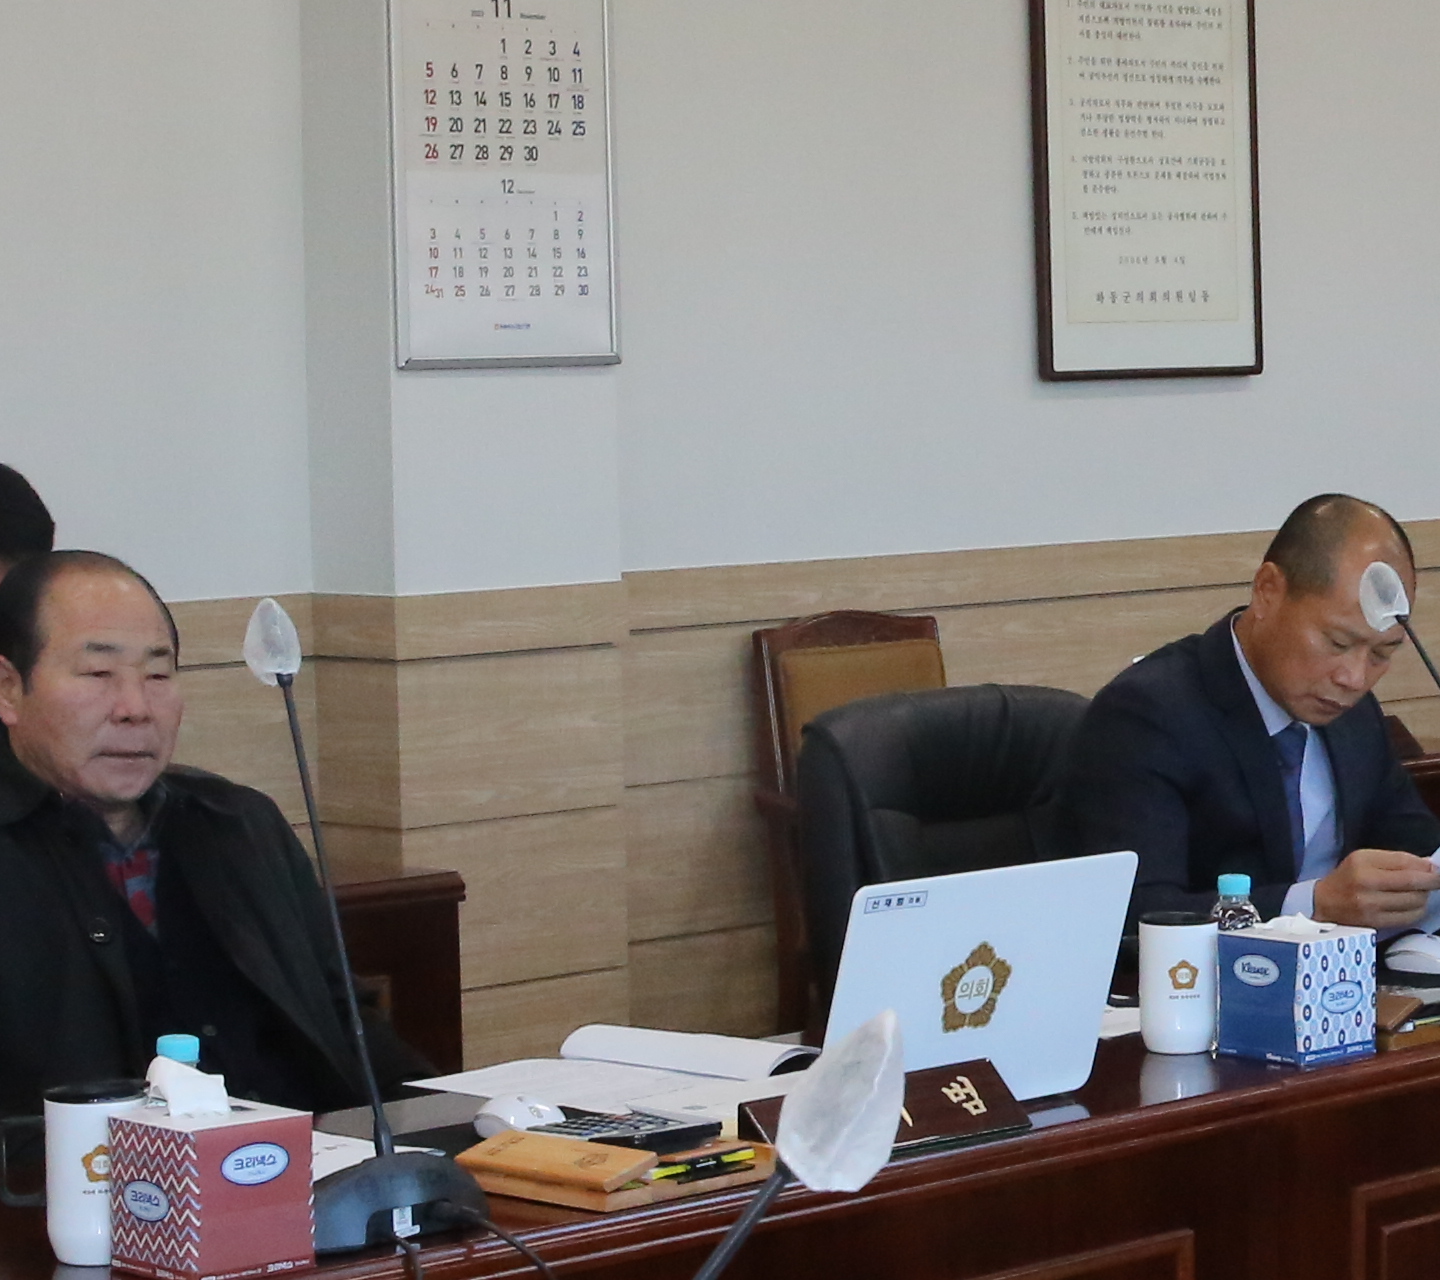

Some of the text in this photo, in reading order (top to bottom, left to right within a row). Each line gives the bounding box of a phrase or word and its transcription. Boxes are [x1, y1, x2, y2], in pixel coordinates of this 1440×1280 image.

[501, 38, 580, 57] 1 2 3 4
[426, 62, 582, 83] 5 6 7 8 9 10 11
[424, 89, 584, 110] 12 13 14 15 16 17 18
[425, 116, 586, 136] 19 20 21 22 23 24 25
[425, 143, 538, 161] 26 27 28 29 30
[501, 179, 514, 194] 12
[429, 247, 586, 259] 10 11 12 13 14 15 16
[428, 266, 588, 278] 17 18 19 20 21 22 23
[454, 285, 466, 297] 25
[479, 285, 491, 297] 26
[504, 284, 515, 297] 27
[529, 284, 541, 296] 28
[554, 284, 565, 296] 29
[578, 284, 589, 296] 30
[958, 976, 989, 1001] 의회
[233, 1154, 277, 1171] 크리넥스
